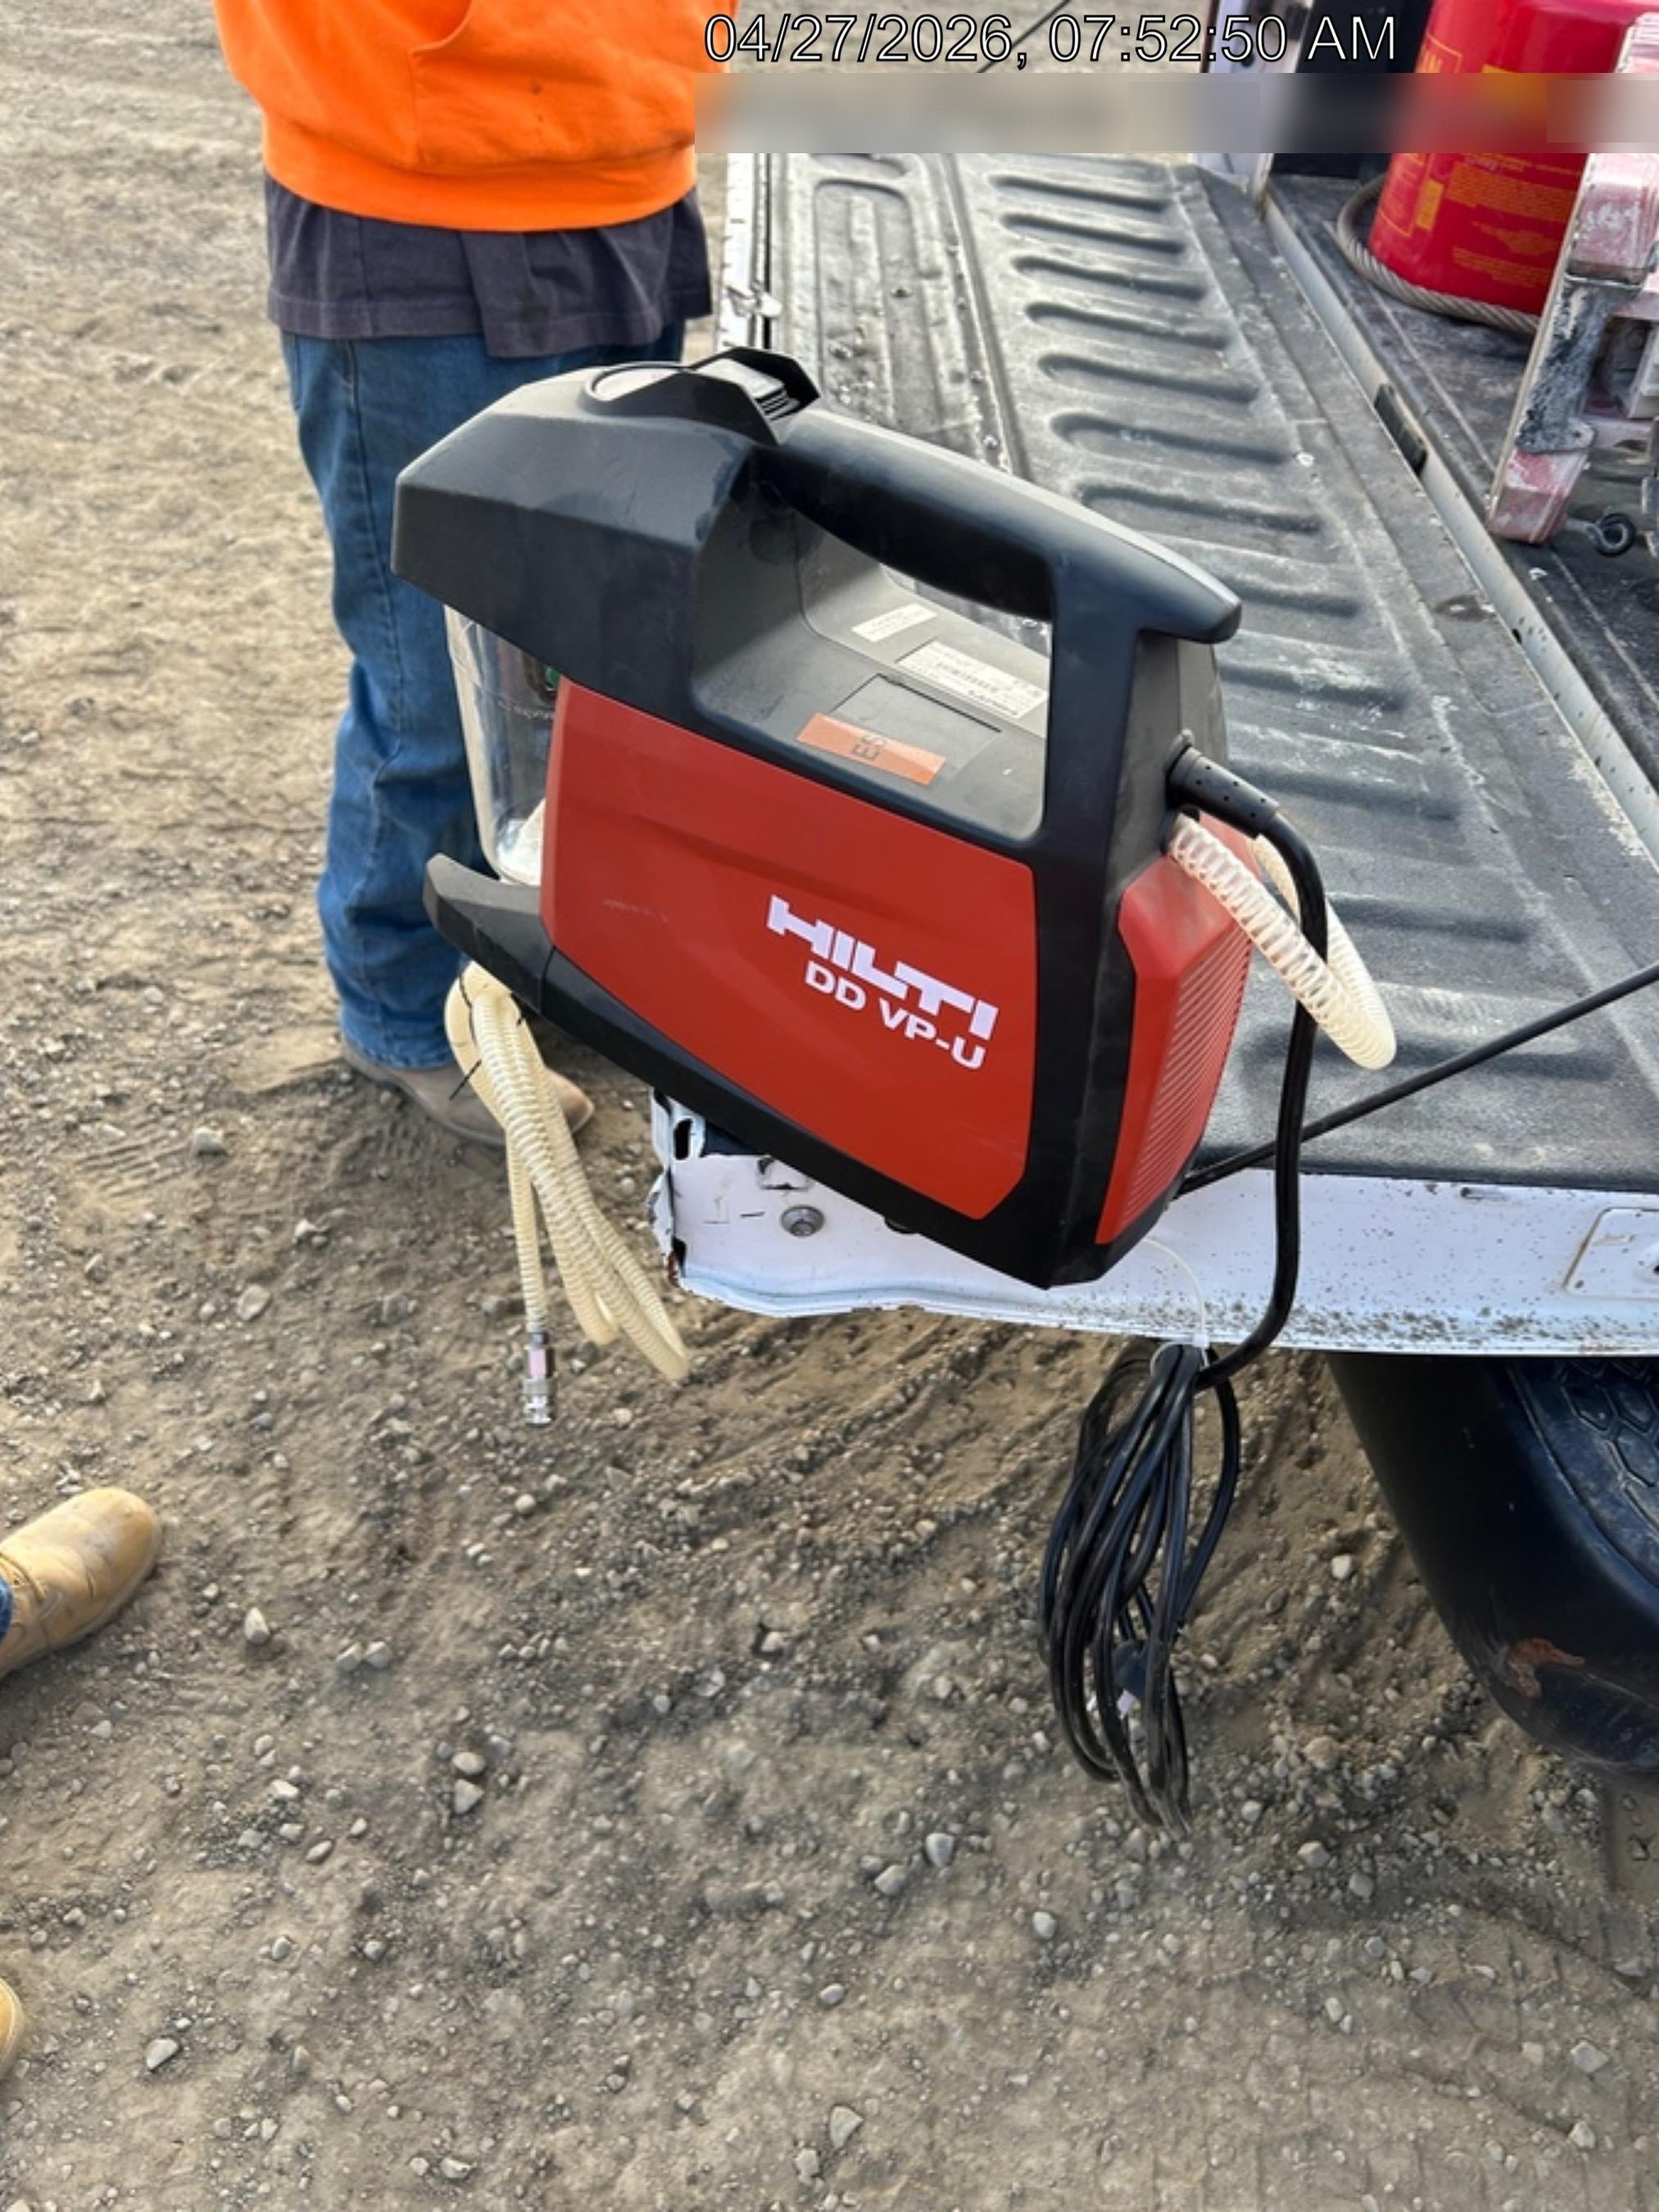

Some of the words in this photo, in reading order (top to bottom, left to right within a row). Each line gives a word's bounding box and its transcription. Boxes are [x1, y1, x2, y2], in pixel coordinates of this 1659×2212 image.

[766, 895, 999, 1040] HILTI
[805, 960, 867, 1011] DD
[878, 998, 987, 1070] VP-U
